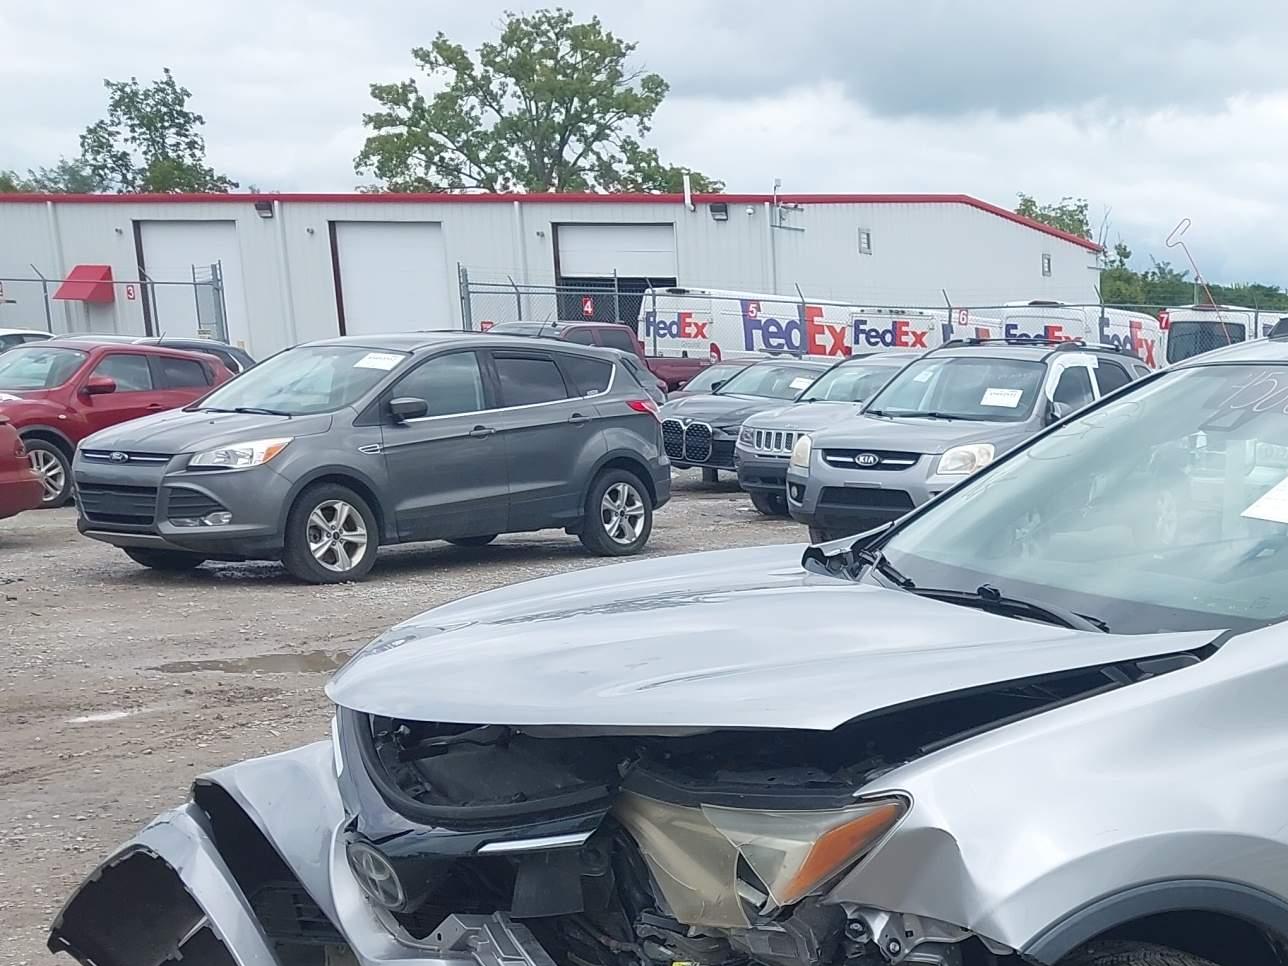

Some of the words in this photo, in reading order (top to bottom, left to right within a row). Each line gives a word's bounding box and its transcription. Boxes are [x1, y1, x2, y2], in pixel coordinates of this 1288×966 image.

[645, 311, 709, 339] FedEx
[740, 299, 853, 356] FedEx
[853, 319, 929, 349] FedEx
